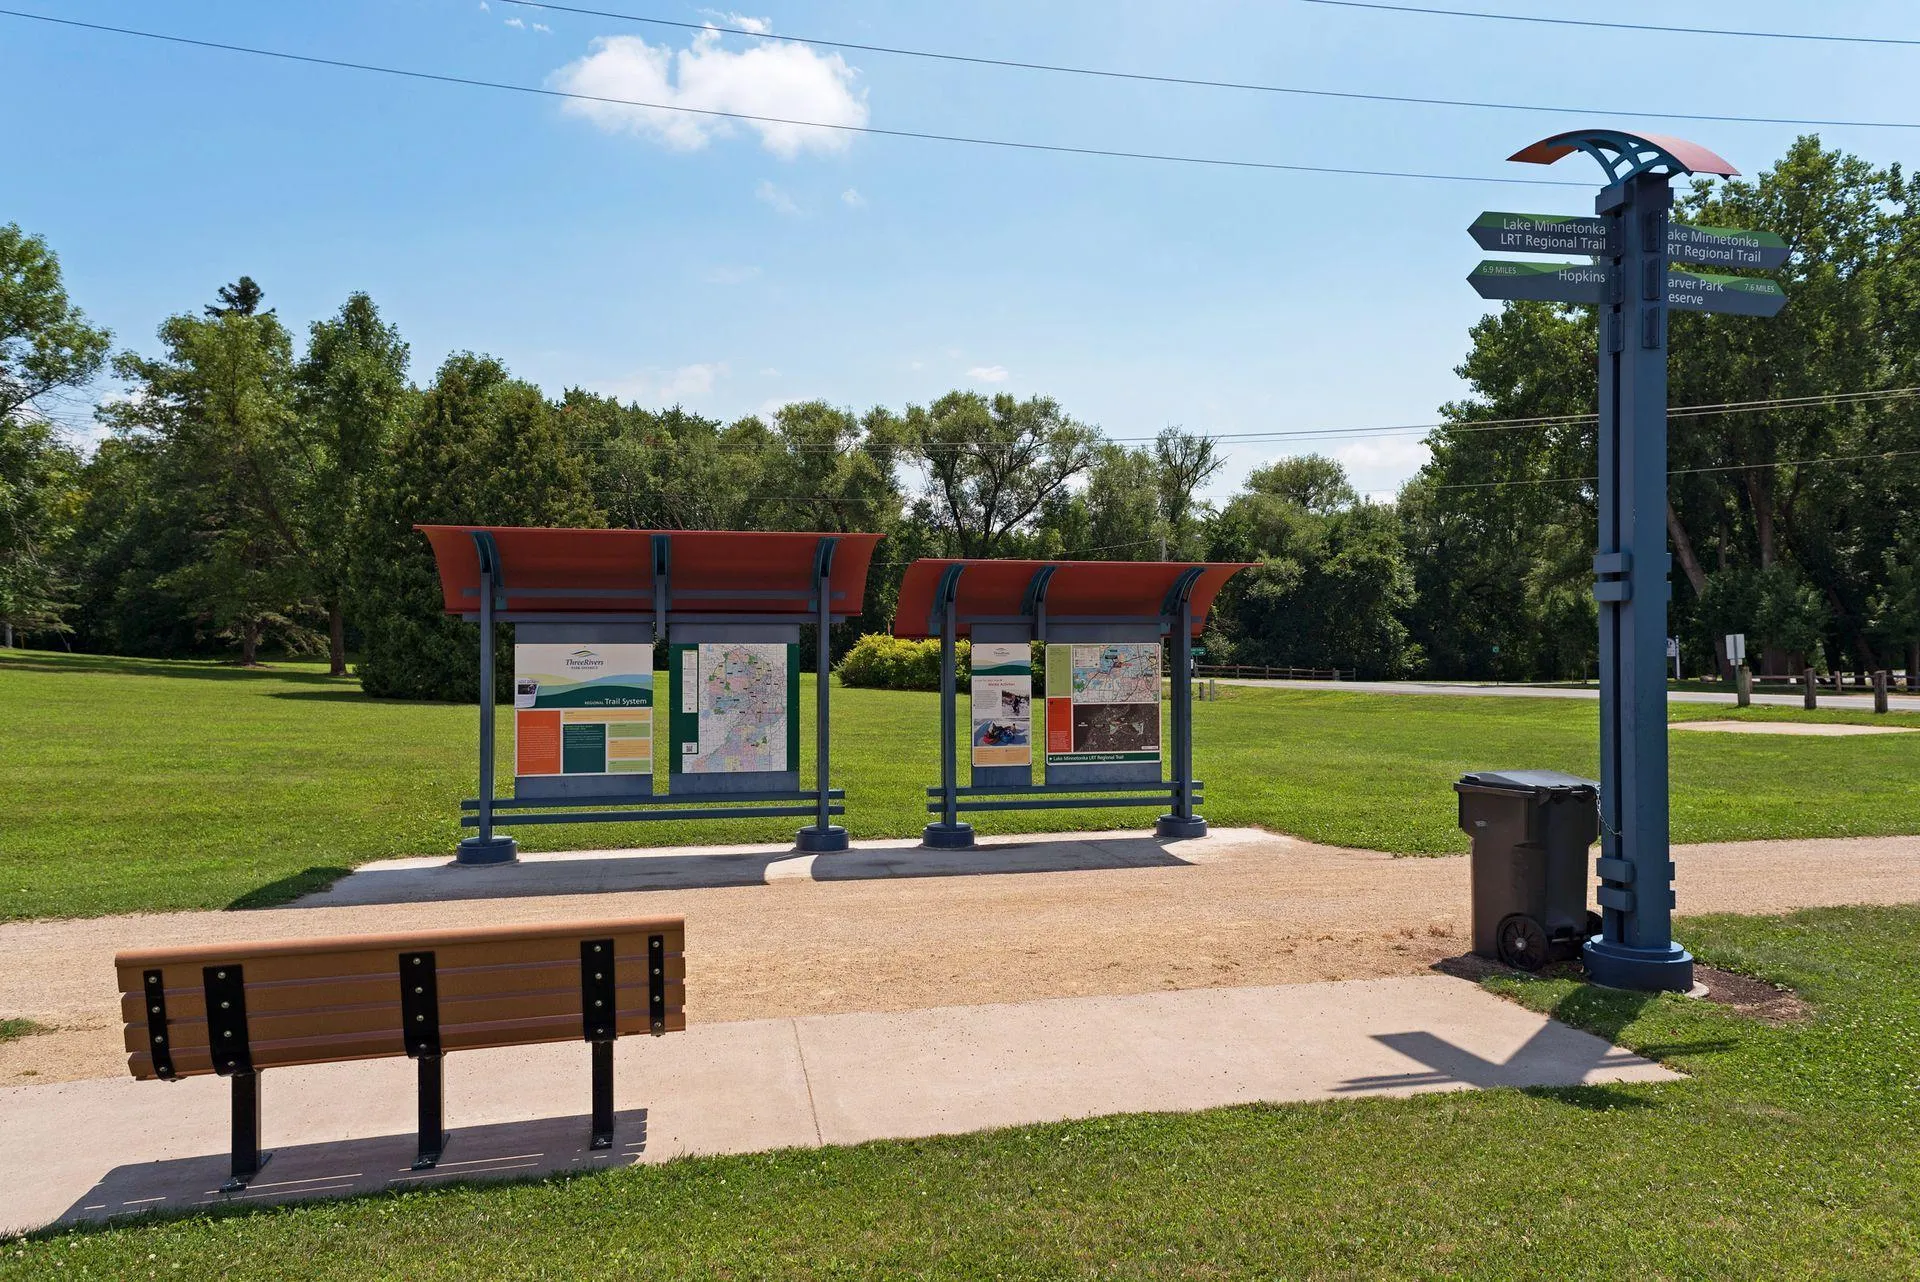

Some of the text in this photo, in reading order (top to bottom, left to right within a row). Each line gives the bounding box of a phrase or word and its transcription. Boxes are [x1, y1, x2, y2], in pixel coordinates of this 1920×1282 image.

[1503, 218, 1606, 236] Lake Minnetonka
[1500, 233, 1606, 250] LRT Regional Trail
[1667, 229, 1759, 248] ake Minnetonka
[1667, 243, 1761, 263] RT Regional Trail
[1482, 266, 1517, 275] 6.9 MILES
[1558, 270, 1606, 284] Hopkins
[1667, 278, 1724, 292] arver Park
[1755, 284, 1775, 293] MILES
[1668, 293, 1704, 305] eserve
[565, 657, 604, 666] ThreeRivers
[622, 698, 647, 706] System
